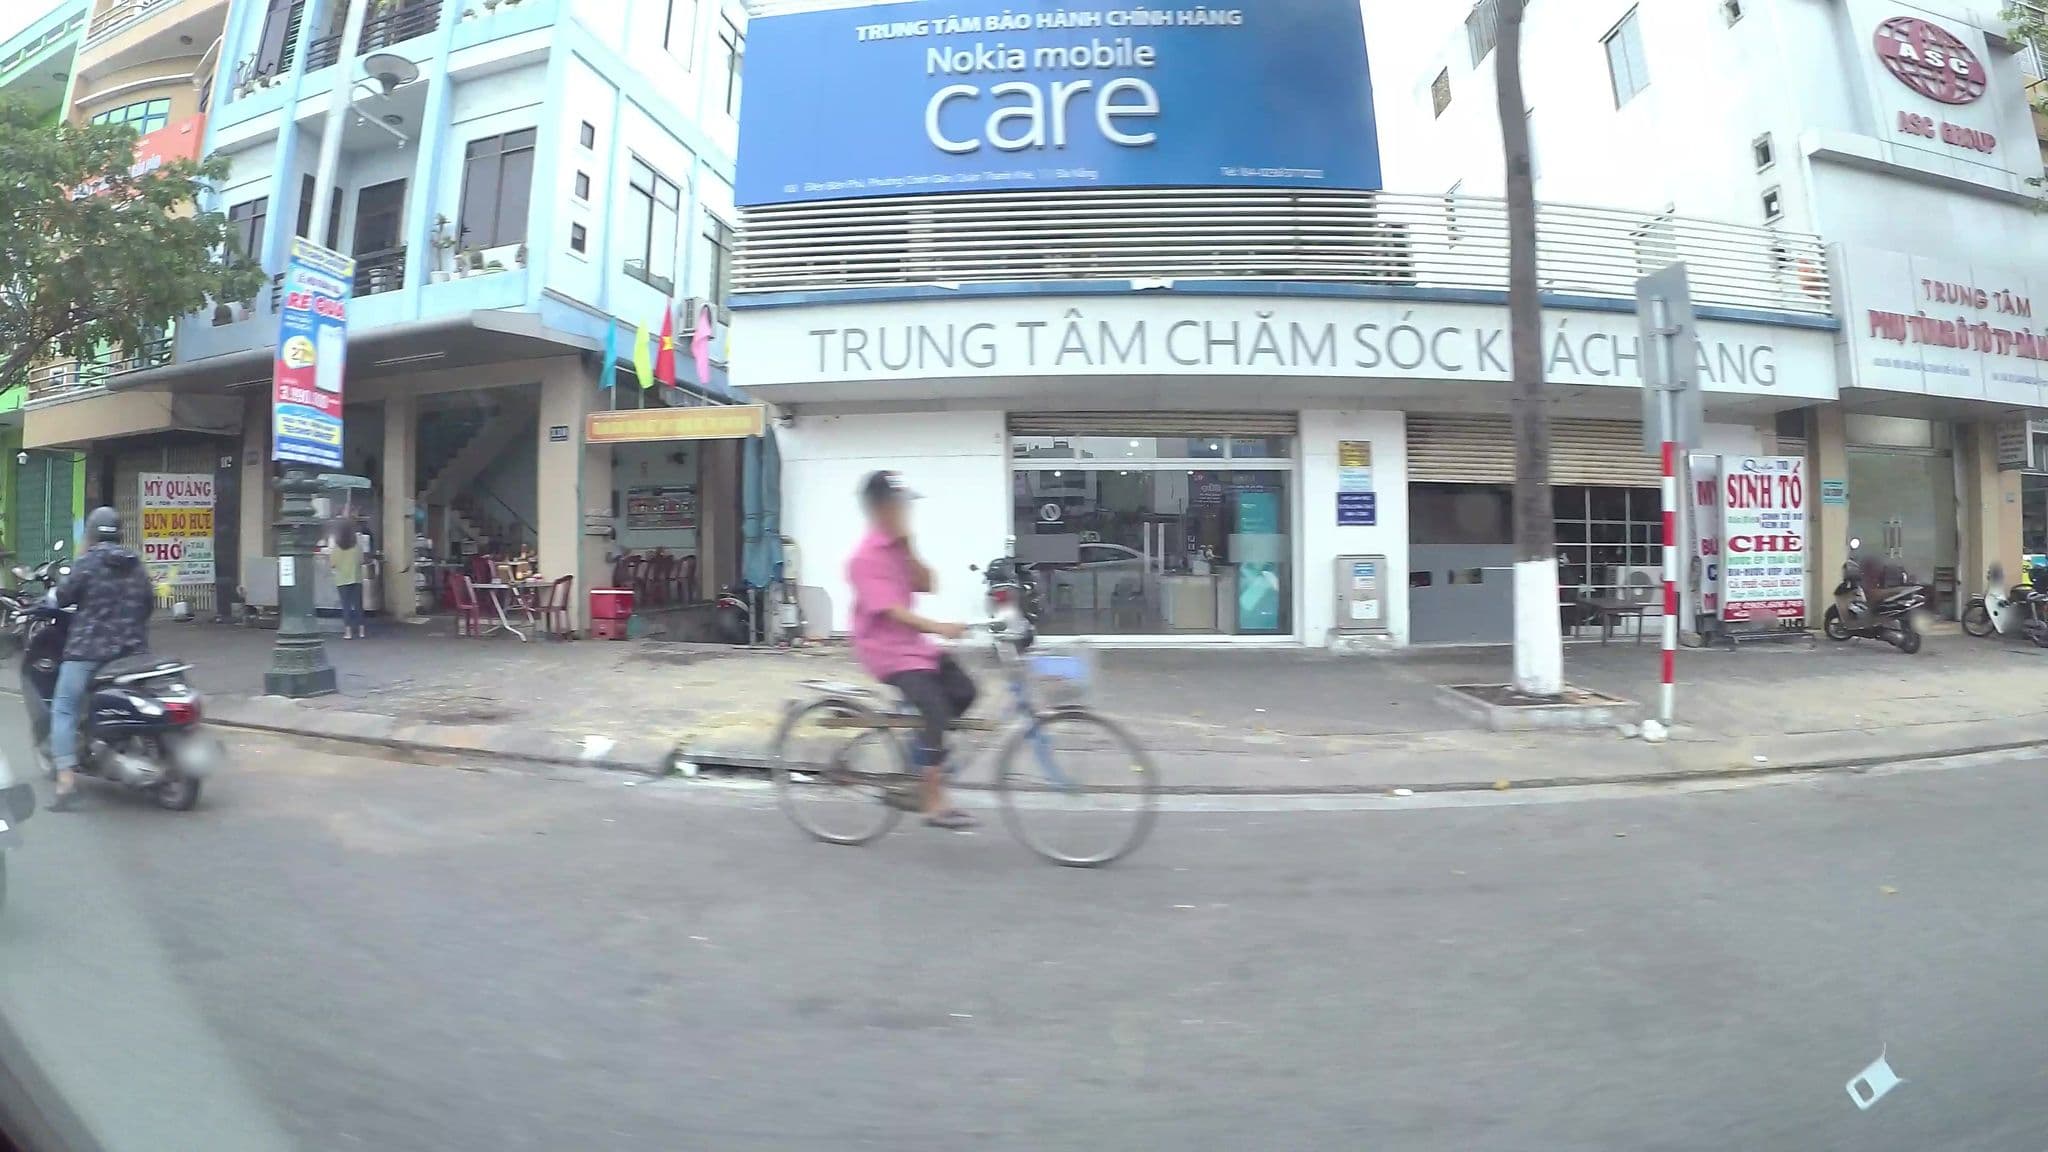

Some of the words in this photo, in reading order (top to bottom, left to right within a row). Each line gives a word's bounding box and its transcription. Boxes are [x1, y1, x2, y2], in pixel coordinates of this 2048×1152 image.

[856, 20, 928, 42] TRUNG
[932, 15, 981, 35] TÂM
[985, 10, 1031, 31] BẢO
[1036, 9, 1101, 29] HÀNH
[1106, 7, 1174, 27] CHÍNH
[926, 43, 1026, 75] Nokia
[1034, 38, 1157, 68] mobile
[925, 77, 1161, 154] care
[1921, 278, 1989, 310] TRUNG
[1993, 288, 2032, 318] TÂM
[809, 322, 997, 373] TRUNG
[1016, 307, 1148, 367] TÂM
[1166, 309, 1337, 367] CHĂM
[1355, 310, 1464, 371] SÓC
[1477, 318, 1641, 378] KÁCH
[1728, 474, 1772, 509] SINH
[1778, 460, 1802, 509] TỐ
[1728, 531, 1803, 552] CHÈ
